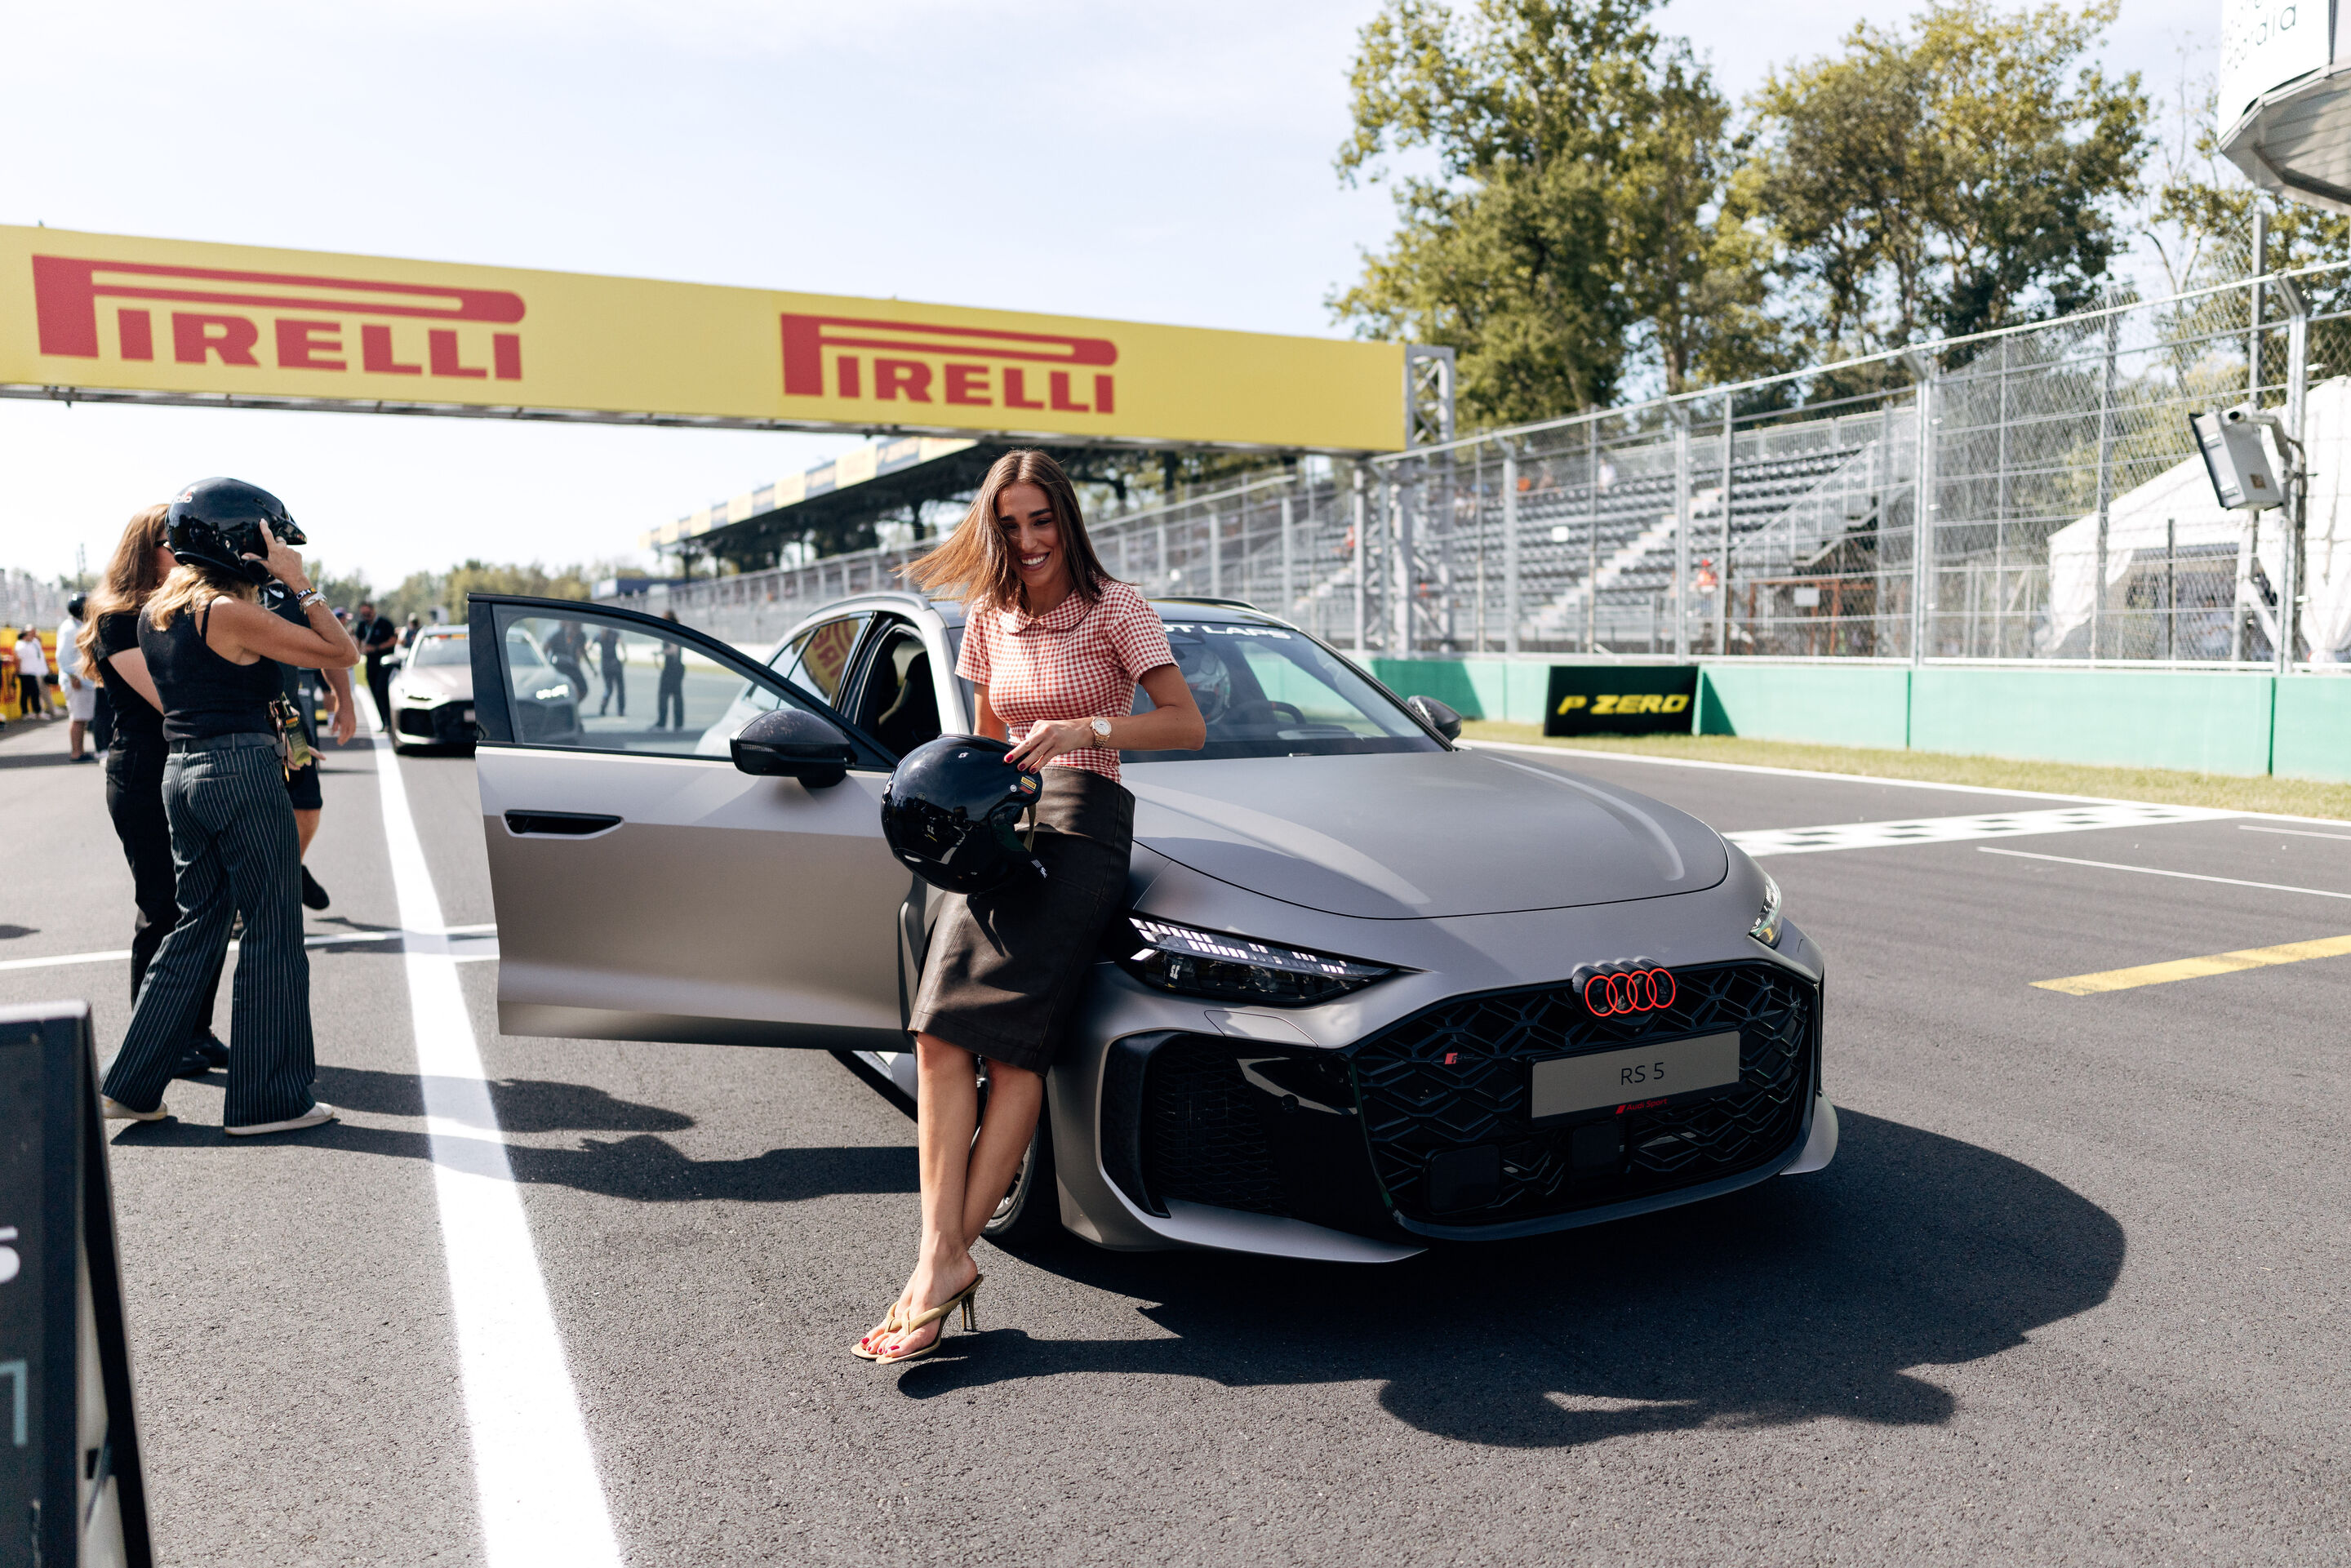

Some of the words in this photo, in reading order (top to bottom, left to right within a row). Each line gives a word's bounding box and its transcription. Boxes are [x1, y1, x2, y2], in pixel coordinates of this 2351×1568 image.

[31, 254, 526, 381] PIRELLI
[780, 313, 1118, 414] PIRELLI
[1202, 625, 1292, 640] LAPS
[1557, 695, 1588, 716] P
[1590, 694, 1691, 715] ZERO
[1620, 1064, 1646, 1086] RS
[1653, 1061, 1664, 1080] 5
[1626, 1101, 1645, 1111] Audi
[1646, 1098, 1669, 1108] Sport
